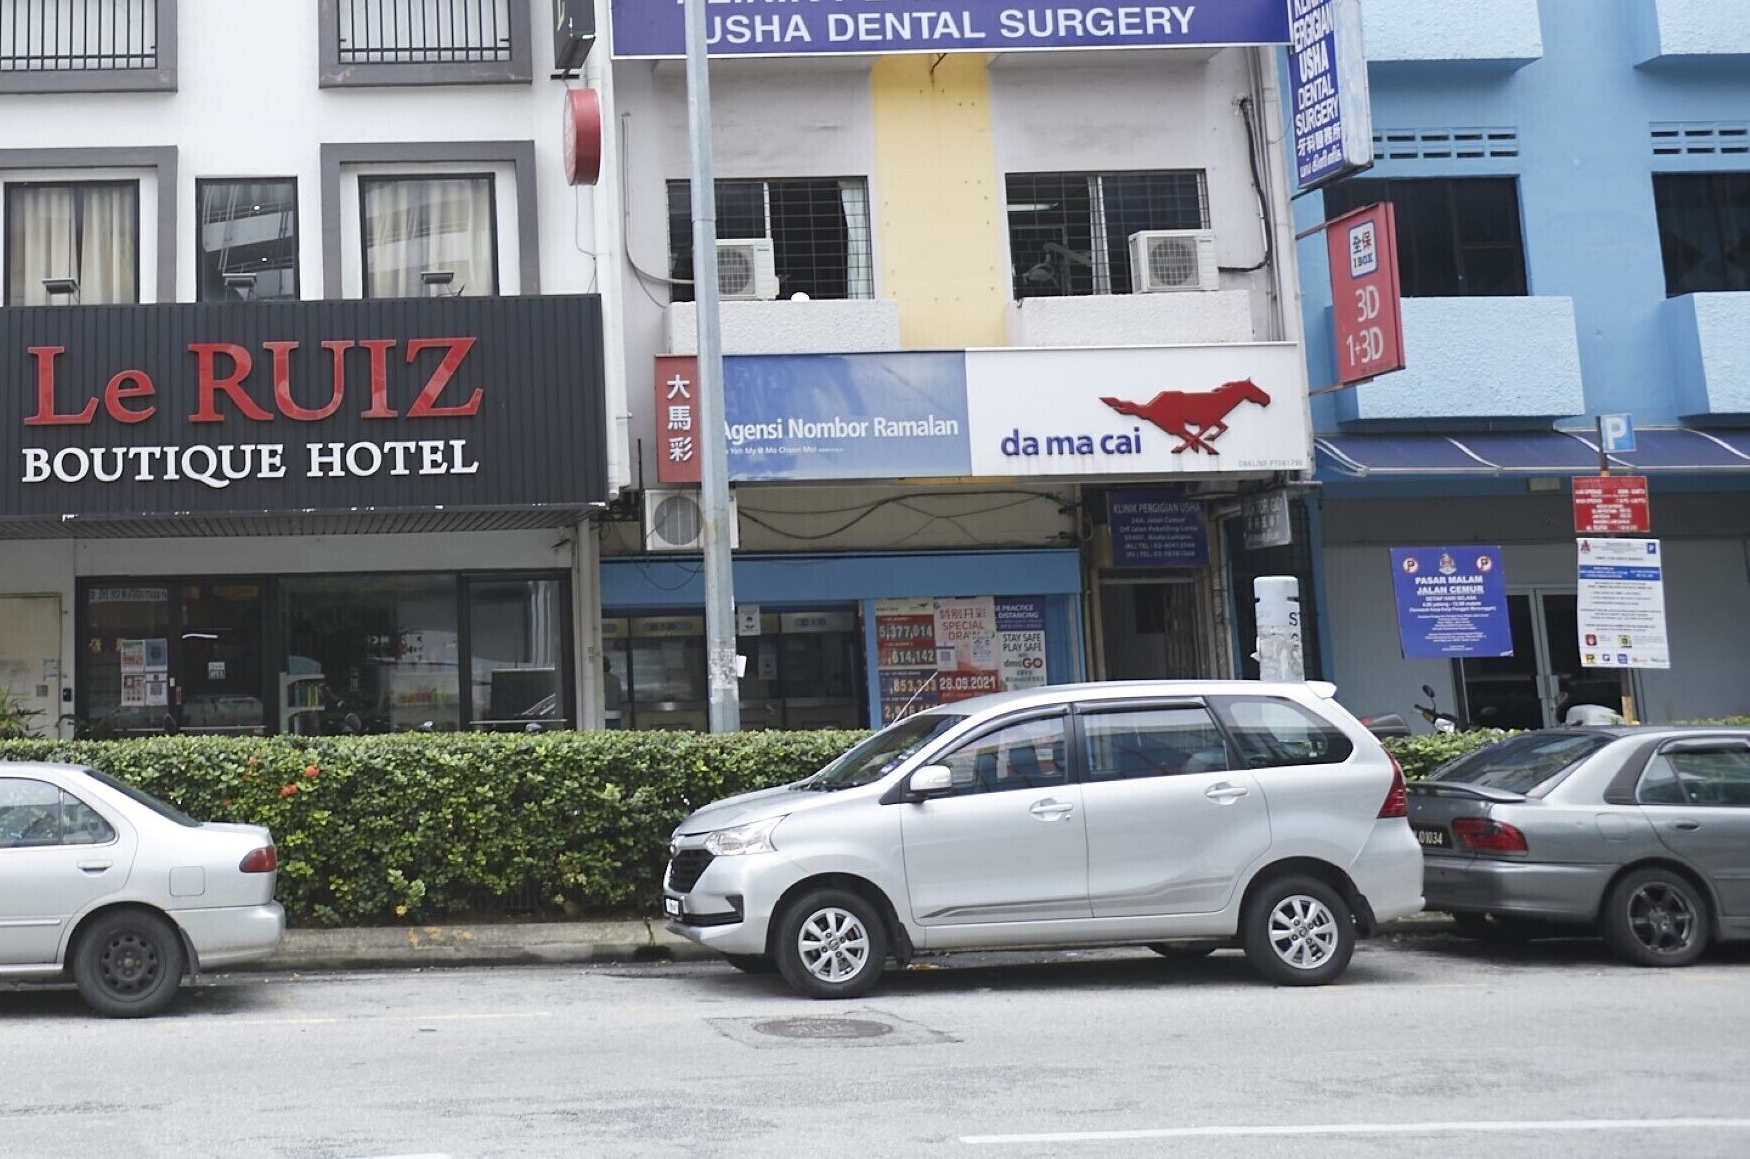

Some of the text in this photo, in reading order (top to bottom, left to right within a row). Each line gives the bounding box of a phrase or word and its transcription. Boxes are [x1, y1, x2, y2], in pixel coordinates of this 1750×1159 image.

[827, 11, 987, 41] DENTAL
[999, 6, 1195, 38] SURGERY
[1291, 0, 1334, 54] ERGIGIAN
[1299, 40, 1330, 83] USHA
[1298, 72, 1335, 110] DENTAL
[1295, 93, 1341, 137] SURGERY
[1355, 284, 1380, 323] 3D
[1346, 326, 1384, 367] 1+3D
[23, 336, 485, 426] Le RUIZ
[666, 374, 693, 462] 大馬彩
[788, 416, 869, 439] Nombor
[873, 414, 959, 438] Ramalan
[1606, 416, 1627, 450] P
[22, 438, 479, 489] BOUTIQUE HOTEL
[1415, 575, 1483, 584] PASAR MALAM
[1416, 586, 1448, 595] JALAN
[942, 621, 985, 631] SPECIAL
[998, 611, 1040, 619] DISTANCING
[1002, 633, 1041, 642] STAY SAFE
[1002, 643, 1042, 652] PLAY SAFE
